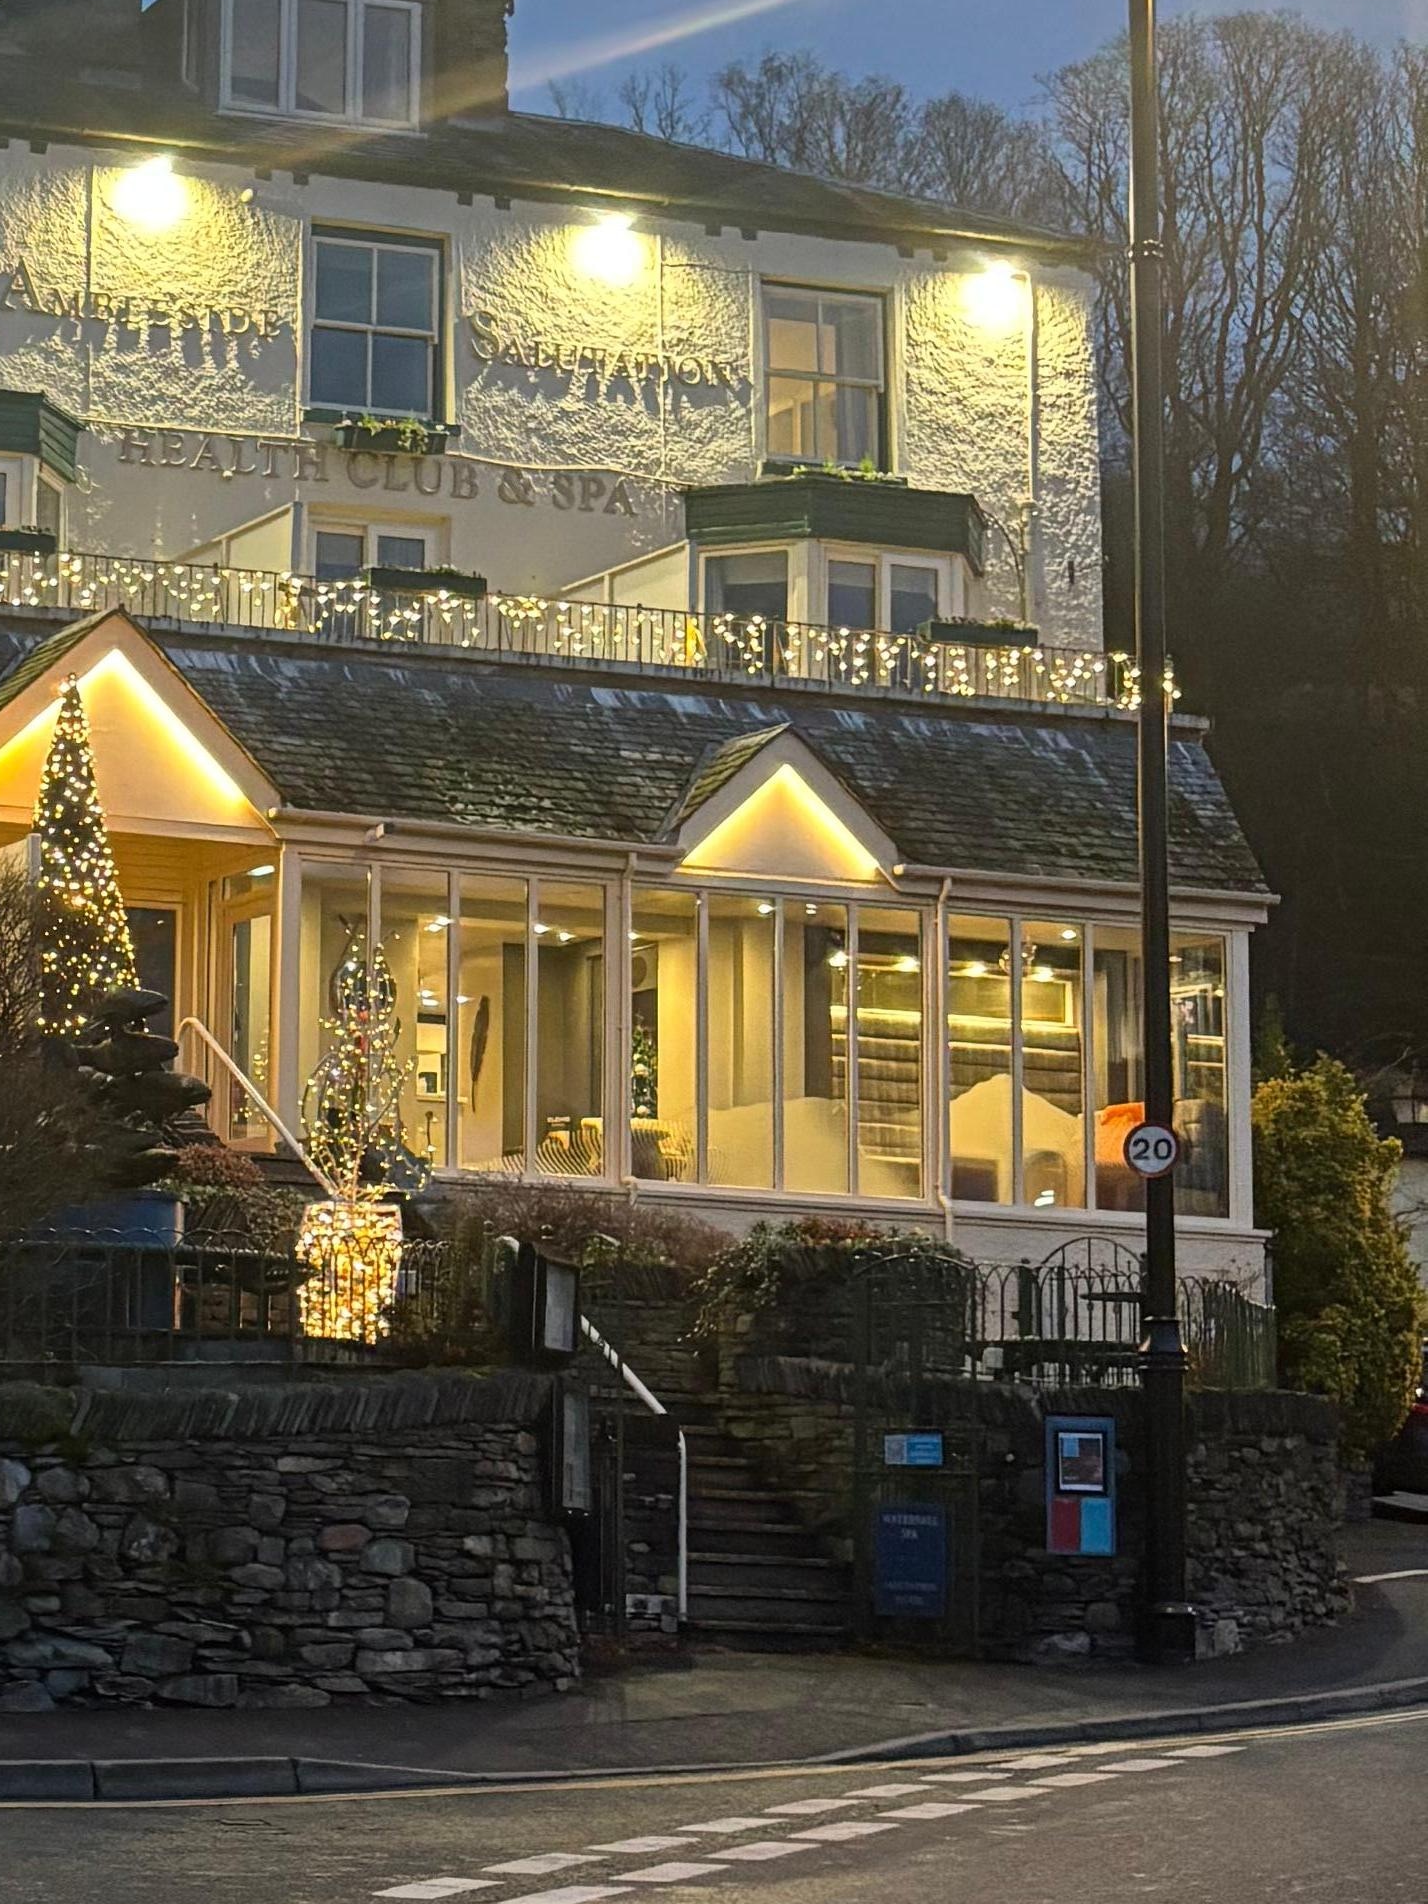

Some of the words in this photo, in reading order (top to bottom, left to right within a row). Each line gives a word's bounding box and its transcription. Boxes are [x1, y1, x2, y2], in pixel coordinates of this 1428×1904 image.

[118, 429, 330, 483] HEALTH
[346, 451, 481, 500] CLUB
[497, 472, 536, 507] &
[551, 472, 638, 517] SPA
[1132, 1138, 1172, 1161] 20
